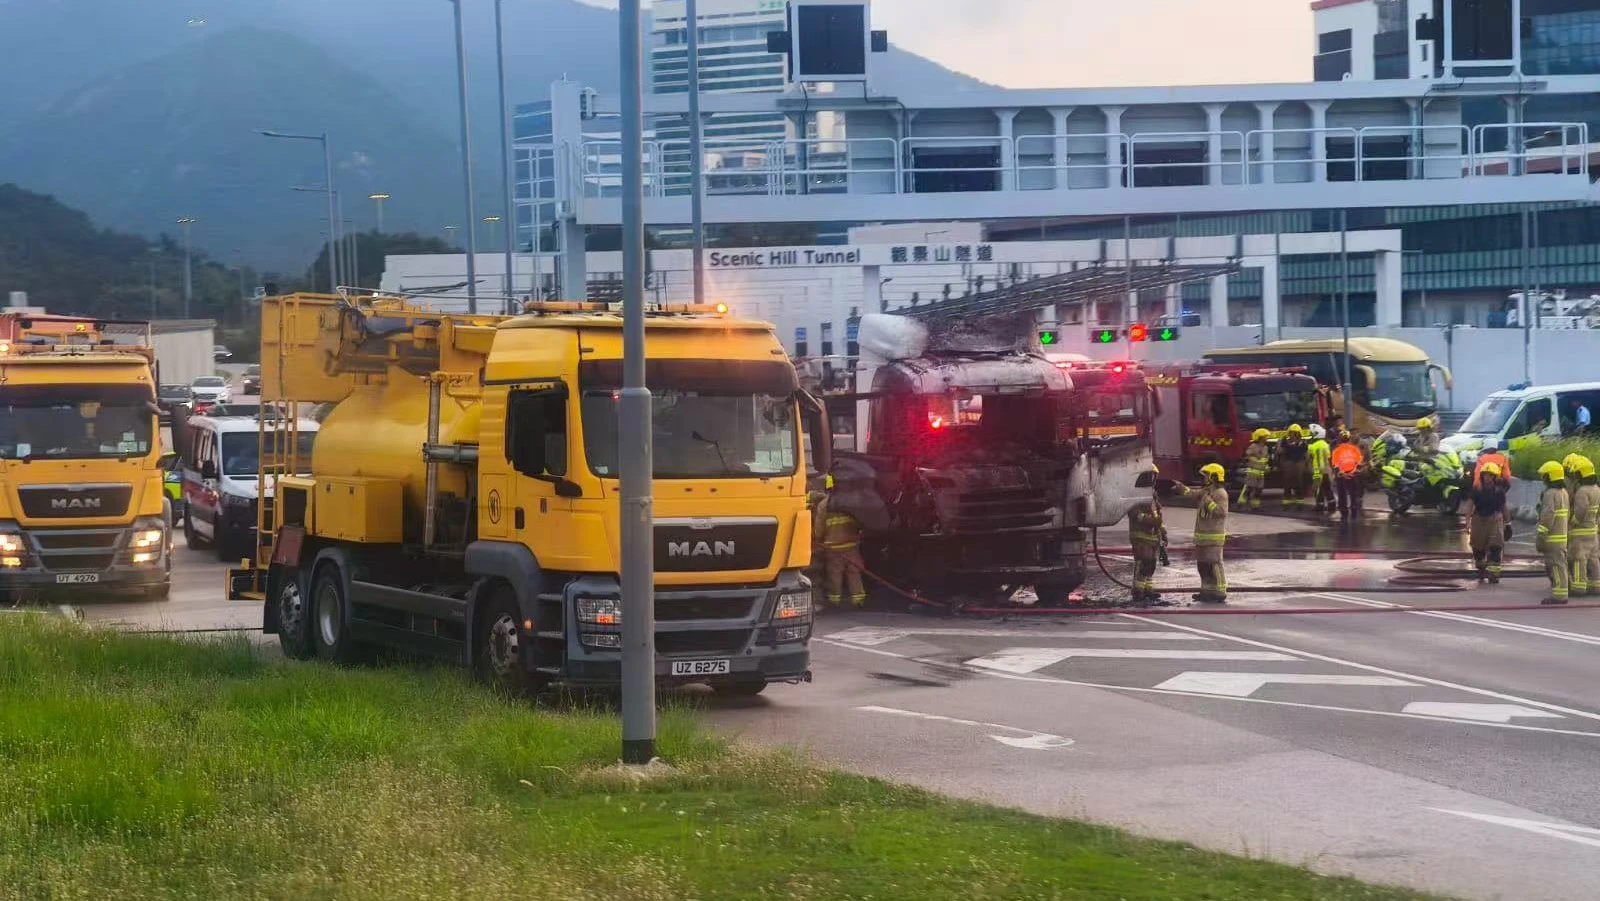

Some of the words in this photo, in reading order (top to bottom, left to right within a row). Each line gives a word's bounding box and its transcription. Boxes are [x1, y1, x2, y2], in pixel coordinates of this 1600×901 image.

[710, 251, 763, 266] Scenic
[770, 250, 796, 265] Hill
[804, 248, 860, 264] Tunnel
[891, 245, 993, 263] 觀景山隧道
[51, 498, 101, 508] MAN
[668, 541, 735, 556] MAN
[74, 574, 96, 582] 4276
[676, 663, 692, 673] UZ
[695, 661, 726, 673] 6275
